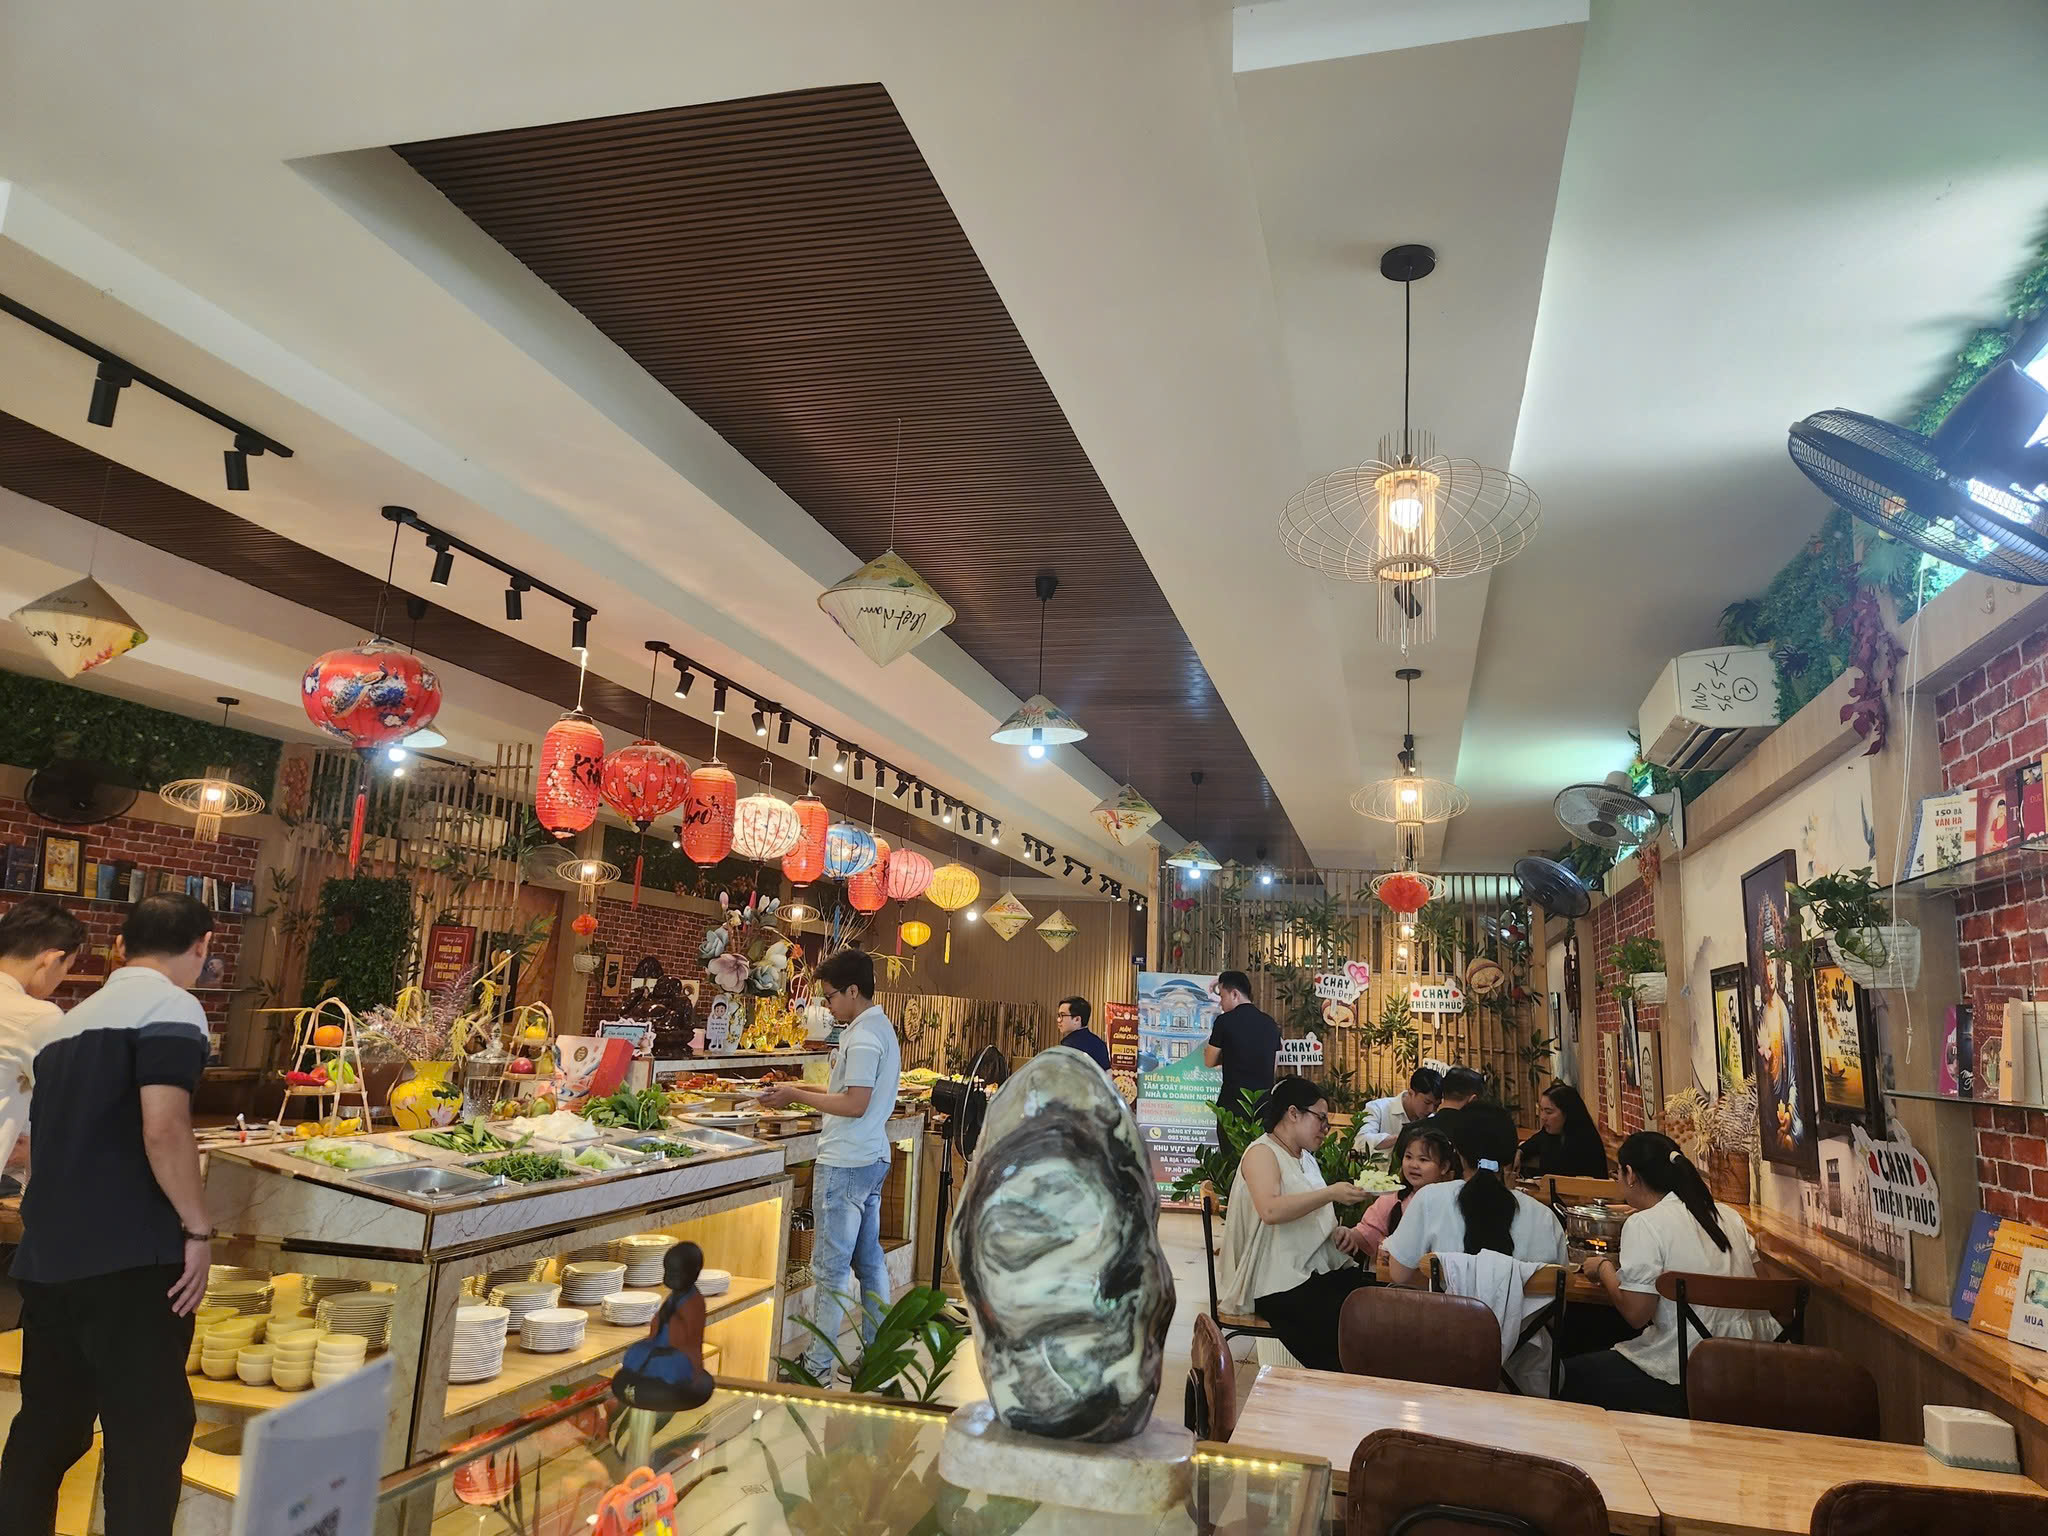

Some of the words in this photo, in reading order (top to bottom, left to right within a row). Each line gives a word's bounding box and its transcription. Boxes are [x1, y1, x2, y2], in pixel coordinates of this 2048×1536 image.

[1952, 816, 1962, 825] HA
[1323, 977, 1350, 989] CHAY
[1422, 989, 1450, 999] CHAY
[1439, 1000, 1462, 1009] PHÚC
[1285, 1042, 1311, 1052] CHAY
[1280, 1053, 1298, 1062] HIÊN
[1877, 1149, 1915, 1187] CHAY
[1905, 1193, 1936, 1227] PHÚC
